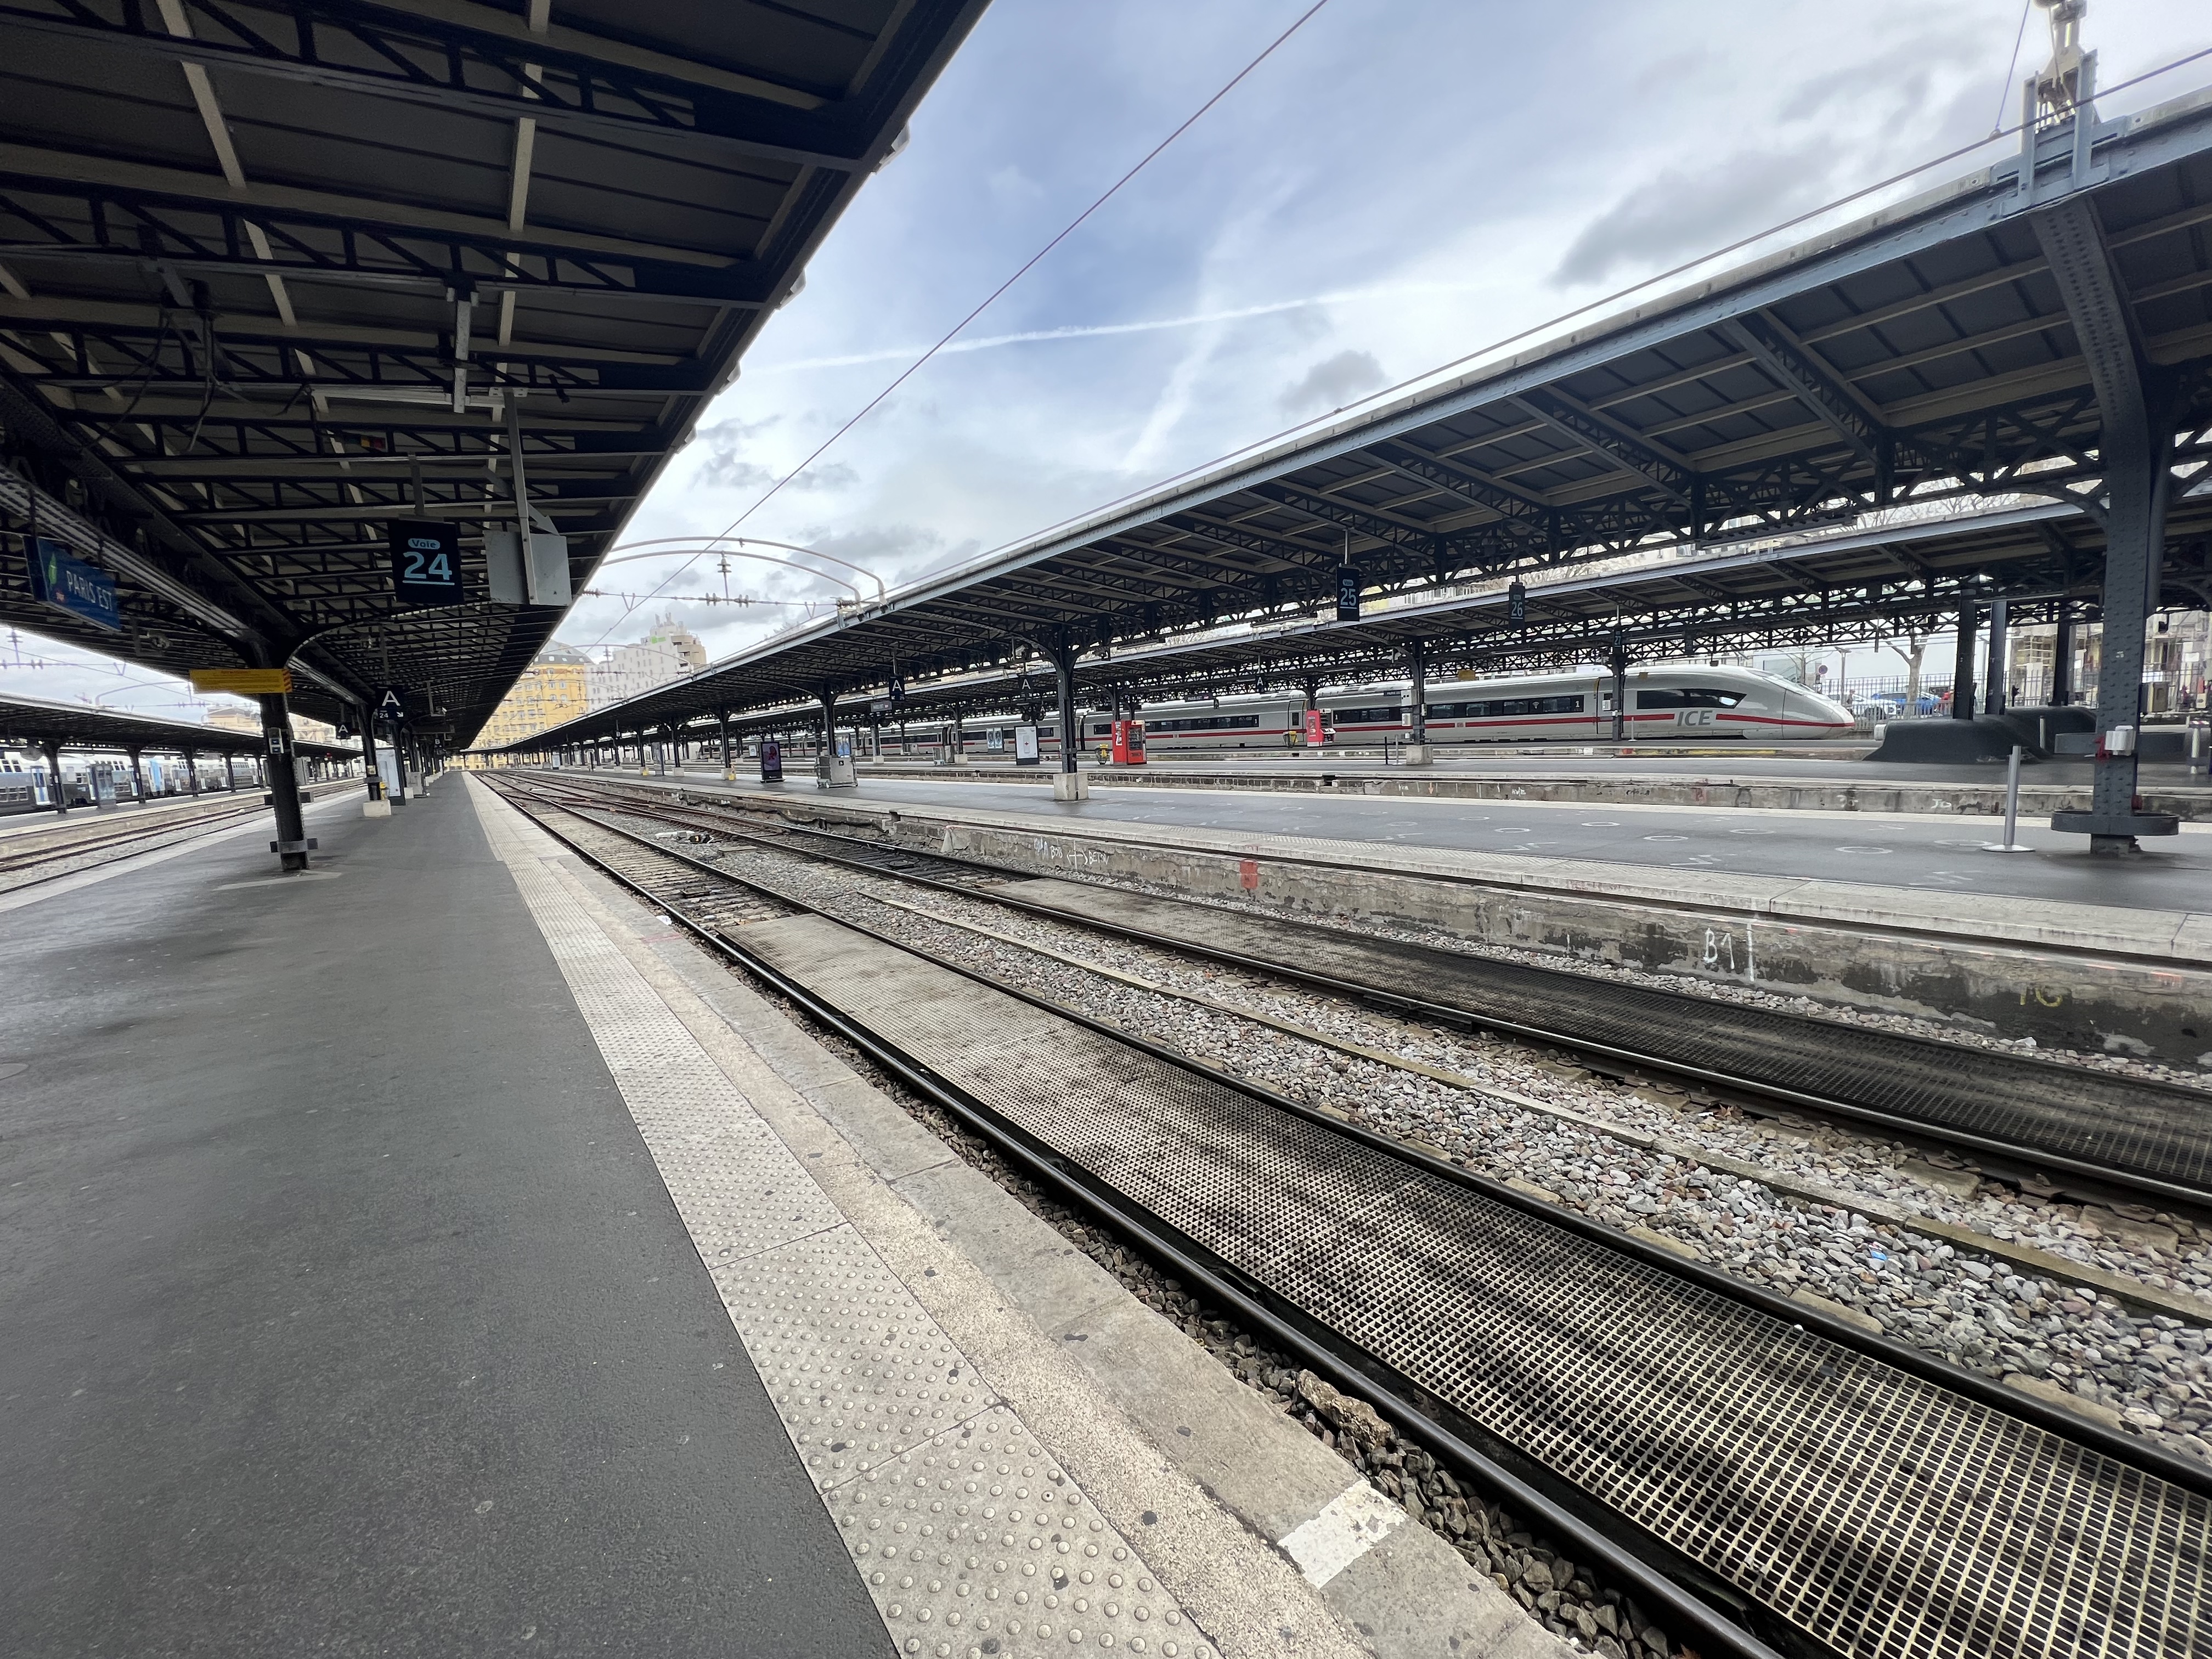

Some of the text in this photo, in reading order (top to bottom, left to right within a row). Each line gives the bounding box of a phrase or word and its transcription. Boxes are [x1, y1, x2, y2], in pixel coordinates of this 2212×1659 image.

[412, 539, 436, 548] Voie
[403, 551, 452, 580] 24
[66, 570, 113, 611] PARIS EST
[1340, 588, 1357, 606] 25
[1511, 601, 1523, 617] 26
[1614, 635, 1622, 645] 27
[892, 680, 902, 692] A
[1022, 679, 1031, 690] A
[1257, 676, 1263, 686] A
[382, 691, 400, 706] A
[1677, 710, 1713, 727] ICE
[338, 725, 348, 733] A
[1703, 927, 1735, 969] B1
